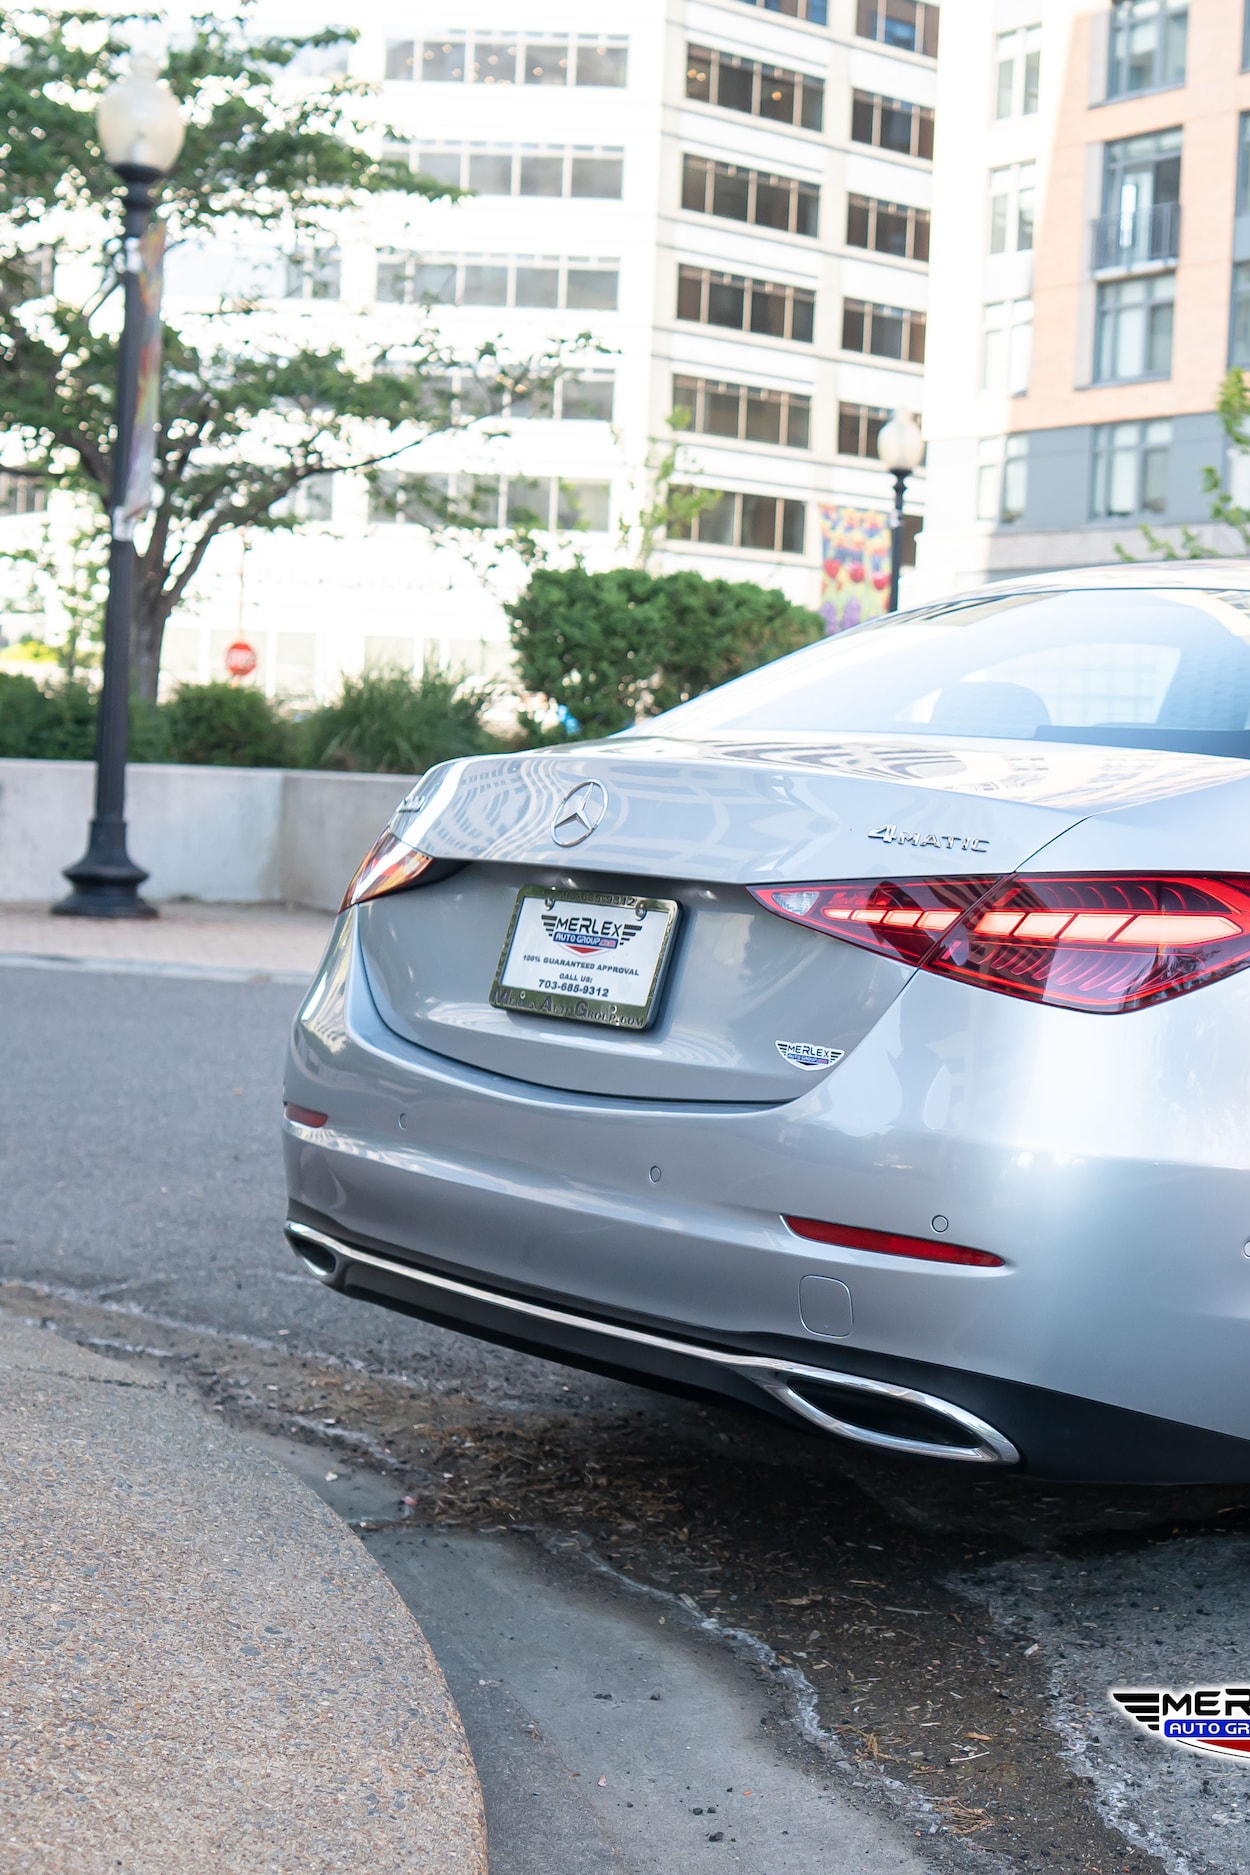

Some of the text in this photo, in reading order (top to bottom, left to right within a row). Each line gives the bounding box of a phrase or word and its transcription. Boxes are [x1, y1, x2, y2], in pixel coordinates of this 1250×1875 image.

[867, 824, 990, 853] 4MATIC
[556, 917, 623, 938] MERLEX
[556, 933, 576, 943] AUTO
[523, 954, 640, 976] 100% GUARANTEED APPROVAL
[559, 972, 593, 983] CALL US:
[787, 1045, 830, 1058] MERLEX
